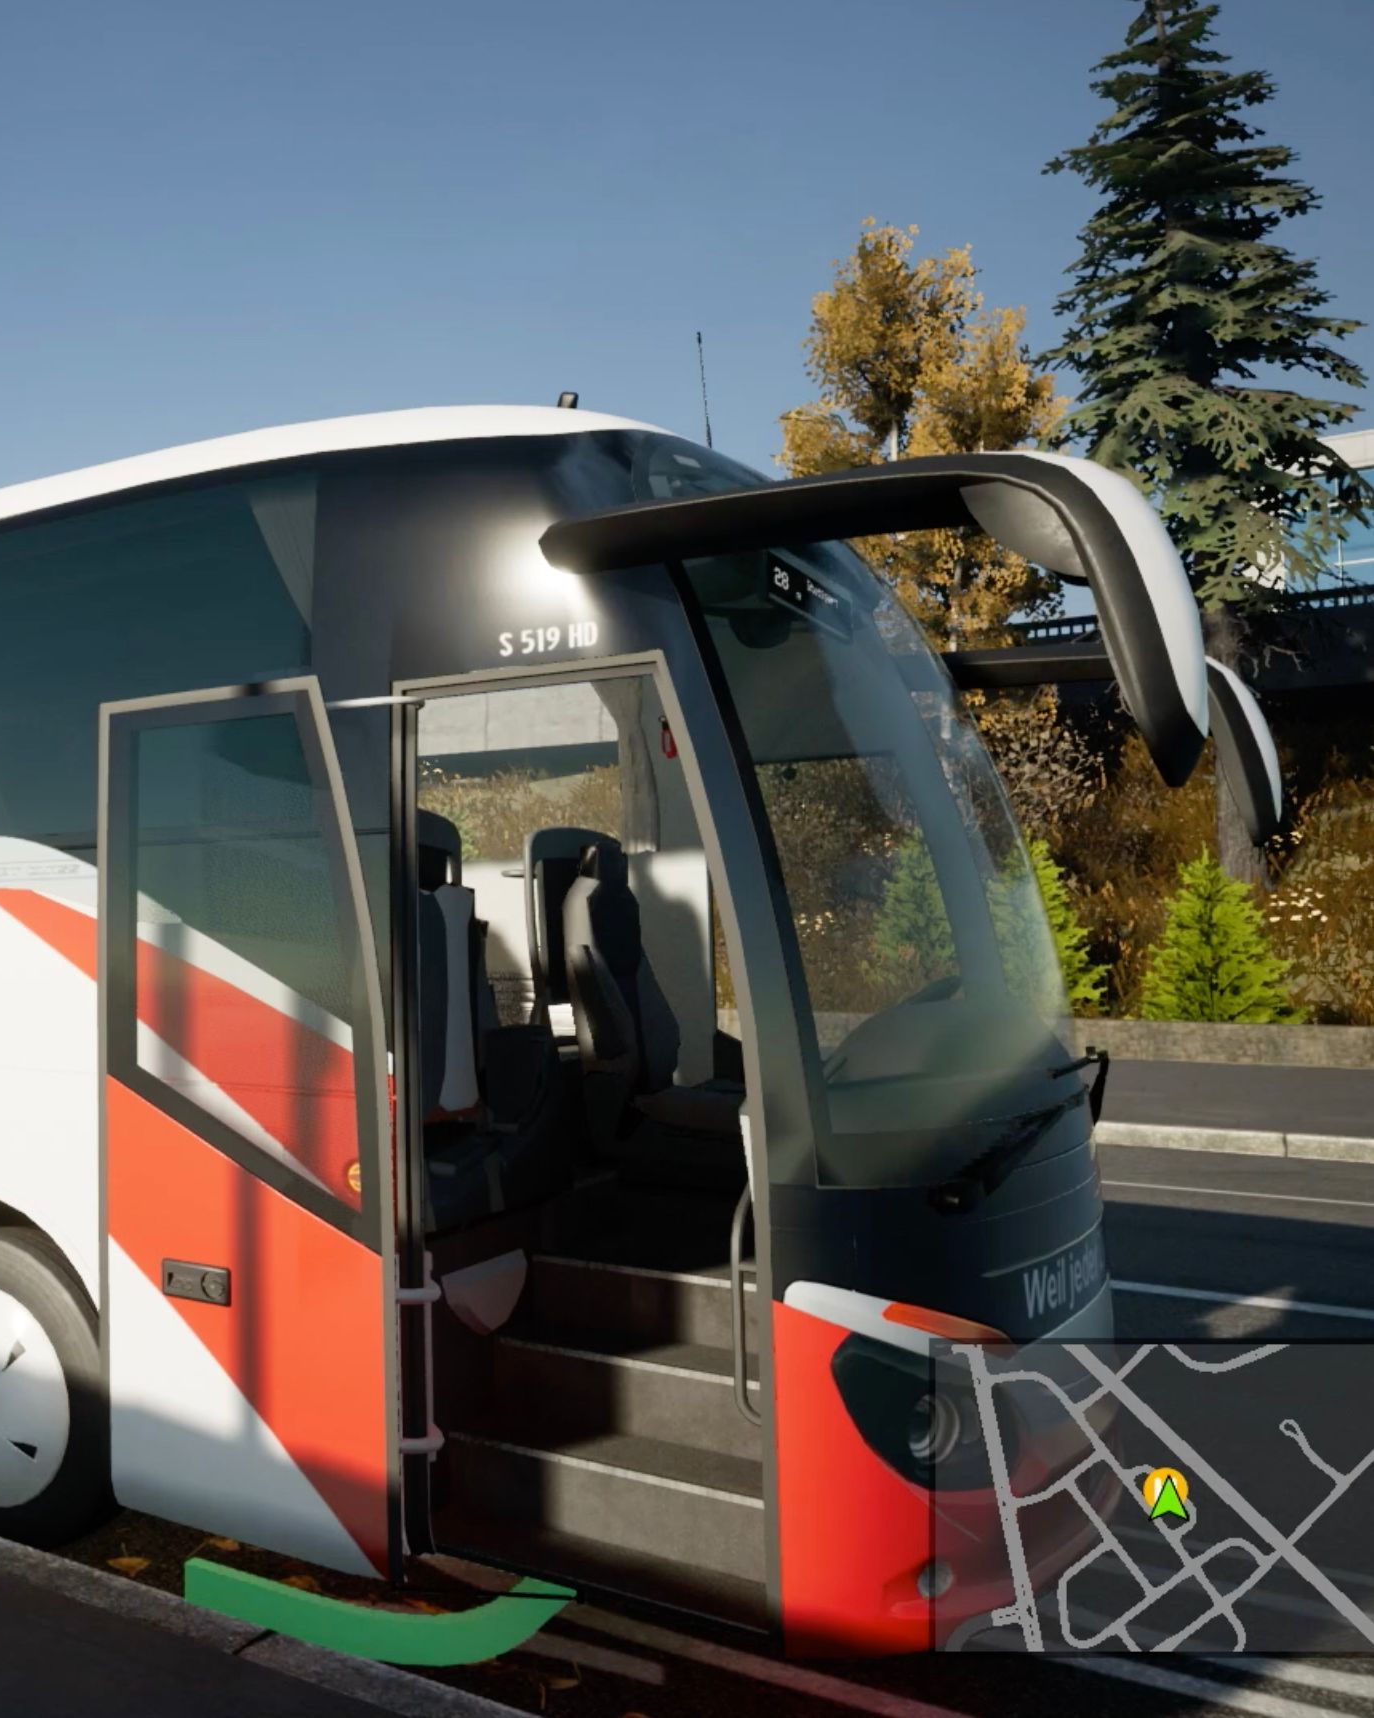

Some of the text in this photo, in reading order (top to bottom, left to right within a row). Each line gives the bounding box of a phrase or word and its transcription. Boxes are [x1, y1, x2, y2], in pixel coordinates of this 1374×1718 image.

[499, 620, 599, 657] S 519 HD
[1023, 1257, 1066, 1319] Weil
